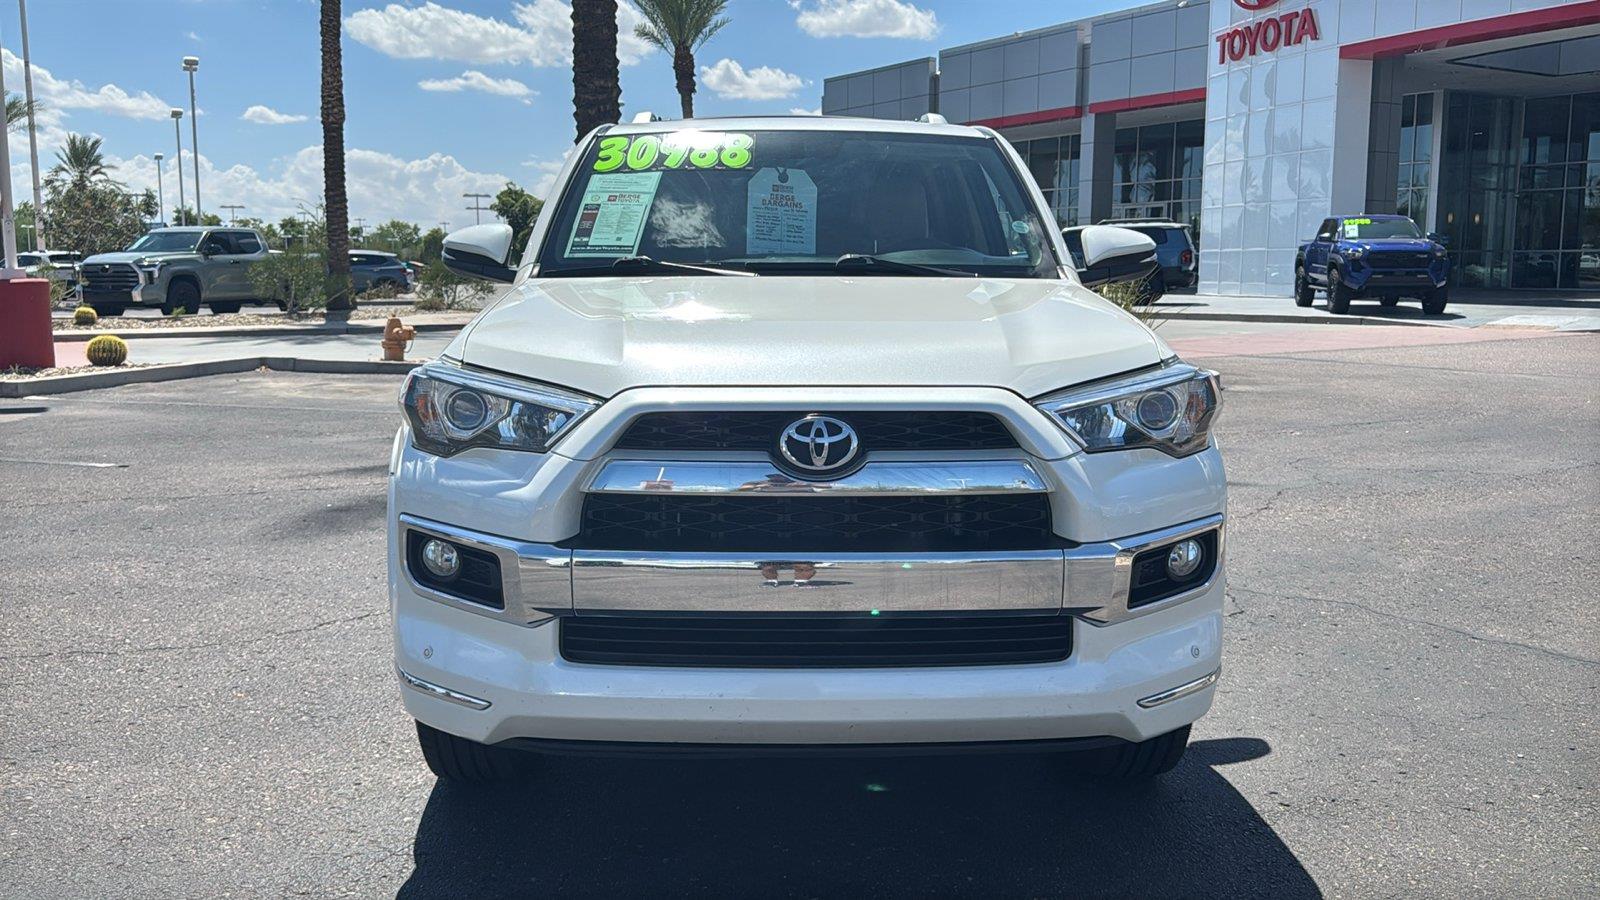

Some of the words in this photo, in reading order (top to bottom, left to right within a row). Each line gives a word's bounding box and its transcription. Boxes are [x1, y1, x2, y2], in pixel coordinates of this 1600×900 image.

[1216, 8, 1319, 65] TOYOTA
[770, 193, 796, 202] BERGE
[762, 199, 803, 209] BARGAINS
